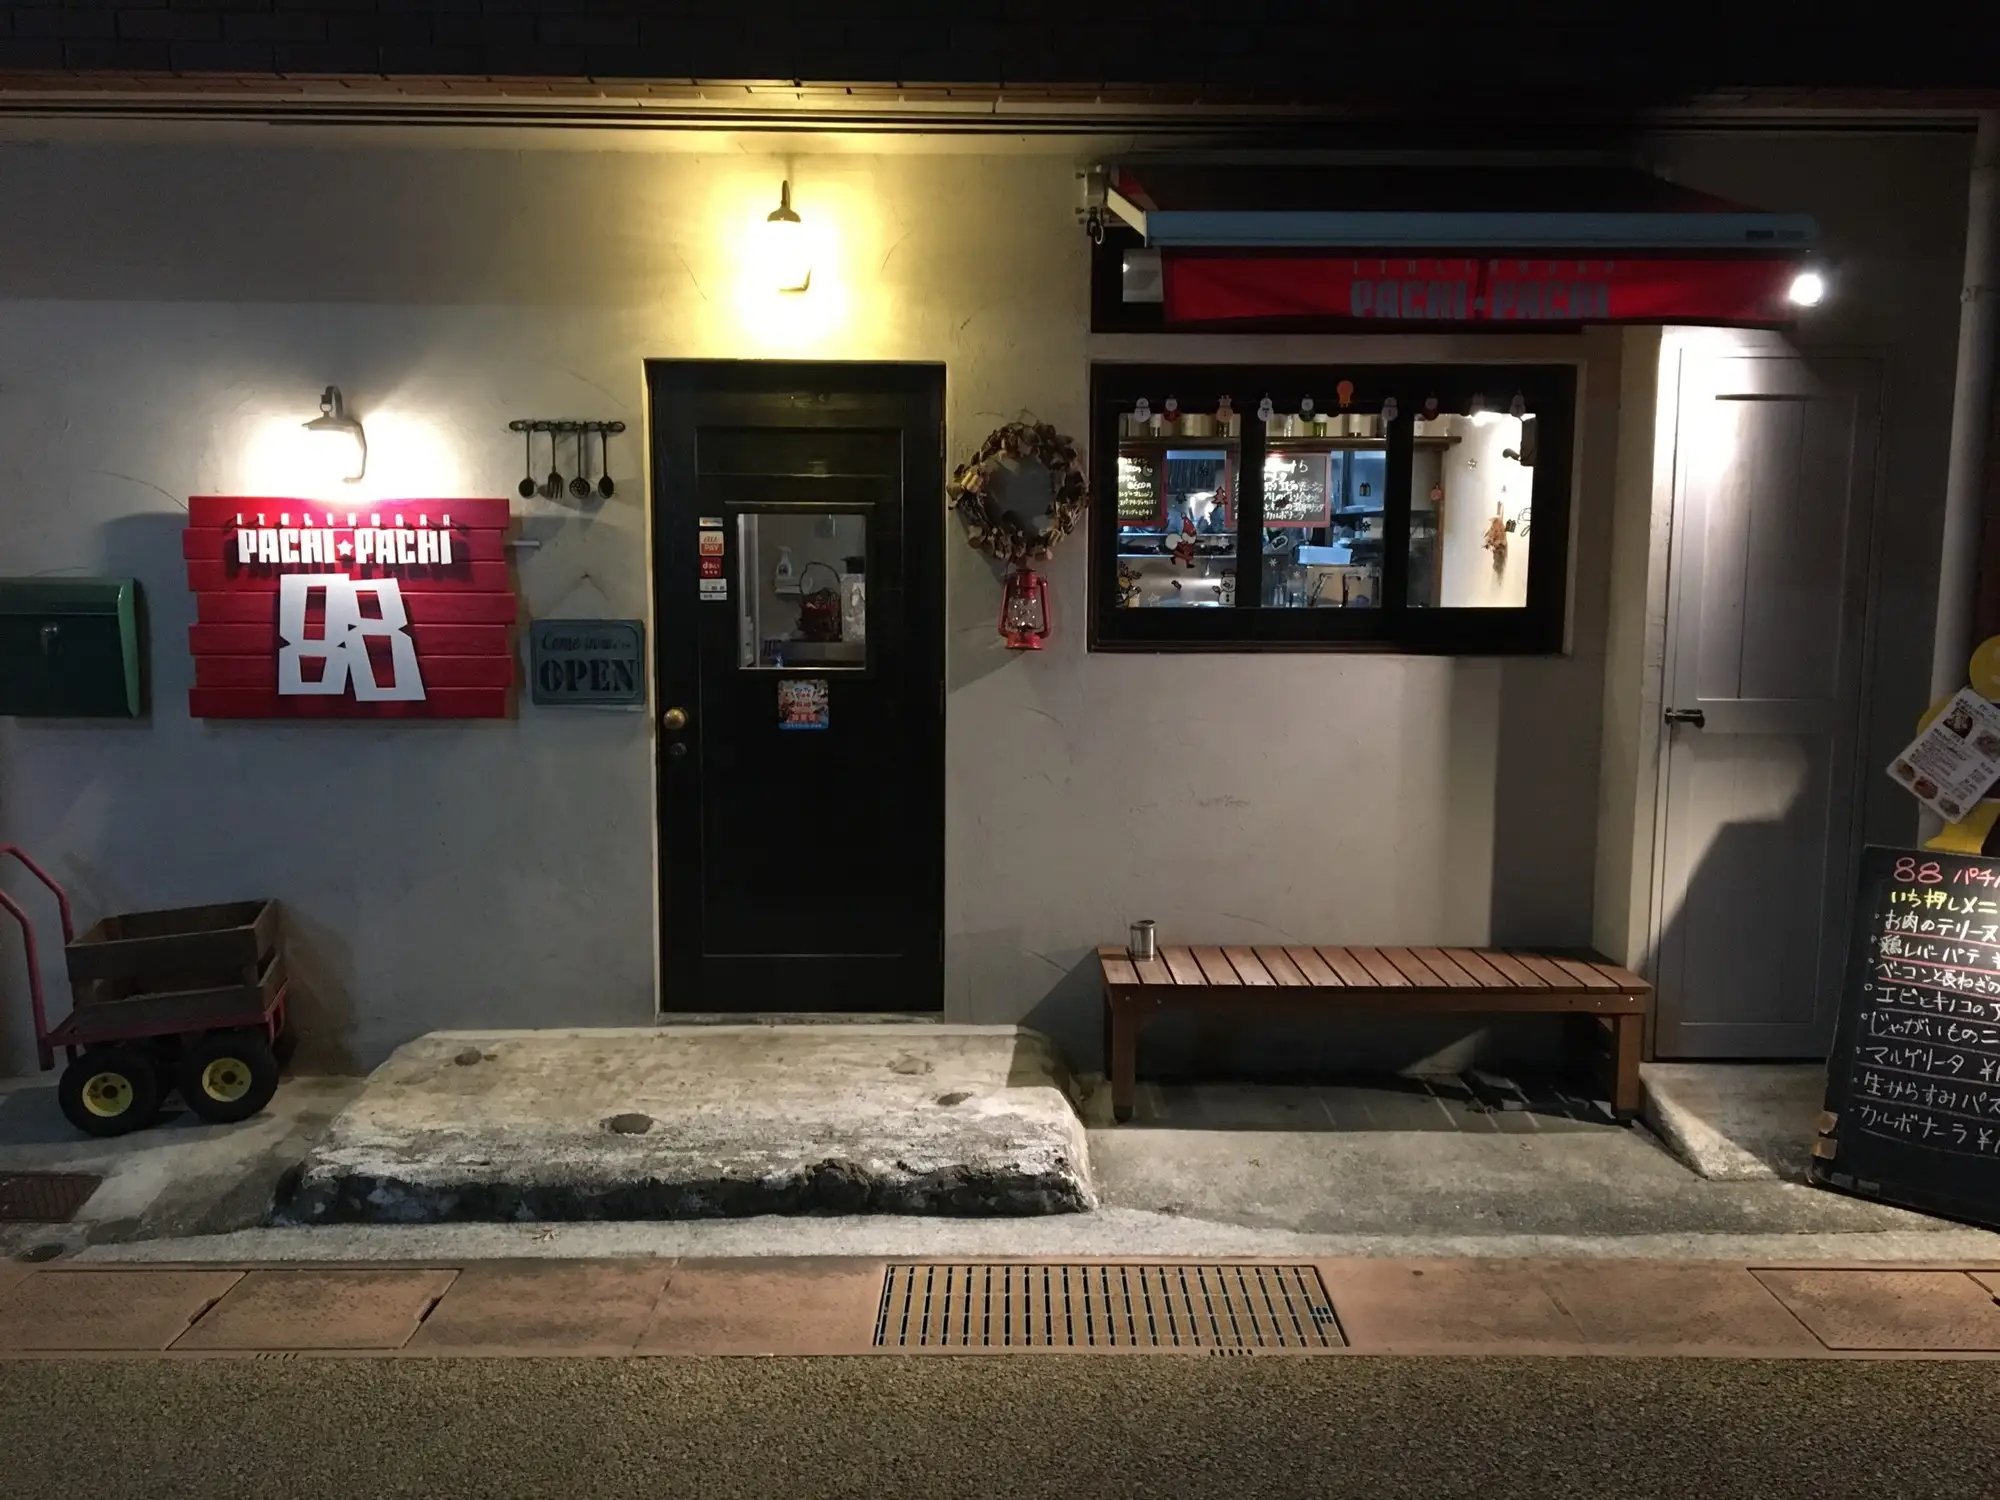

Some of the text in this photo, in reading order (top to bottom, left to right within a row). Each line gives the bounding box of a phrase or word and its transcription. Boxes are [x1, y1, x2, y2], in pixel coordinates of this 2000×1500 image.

[1350, 280, 1610, 319] PACHI PACHI
[237, 528, 452, 564] PACHI PACHI
[278, 573, 426, 702] 88
[540, 658, 638, 692] OPEN
[1893, 857, 1944, 883] 88
[1865, 1046, 1965, 1075] マルゲリータ
[1859, 1105, 1968, 1144] カルボナーラ
